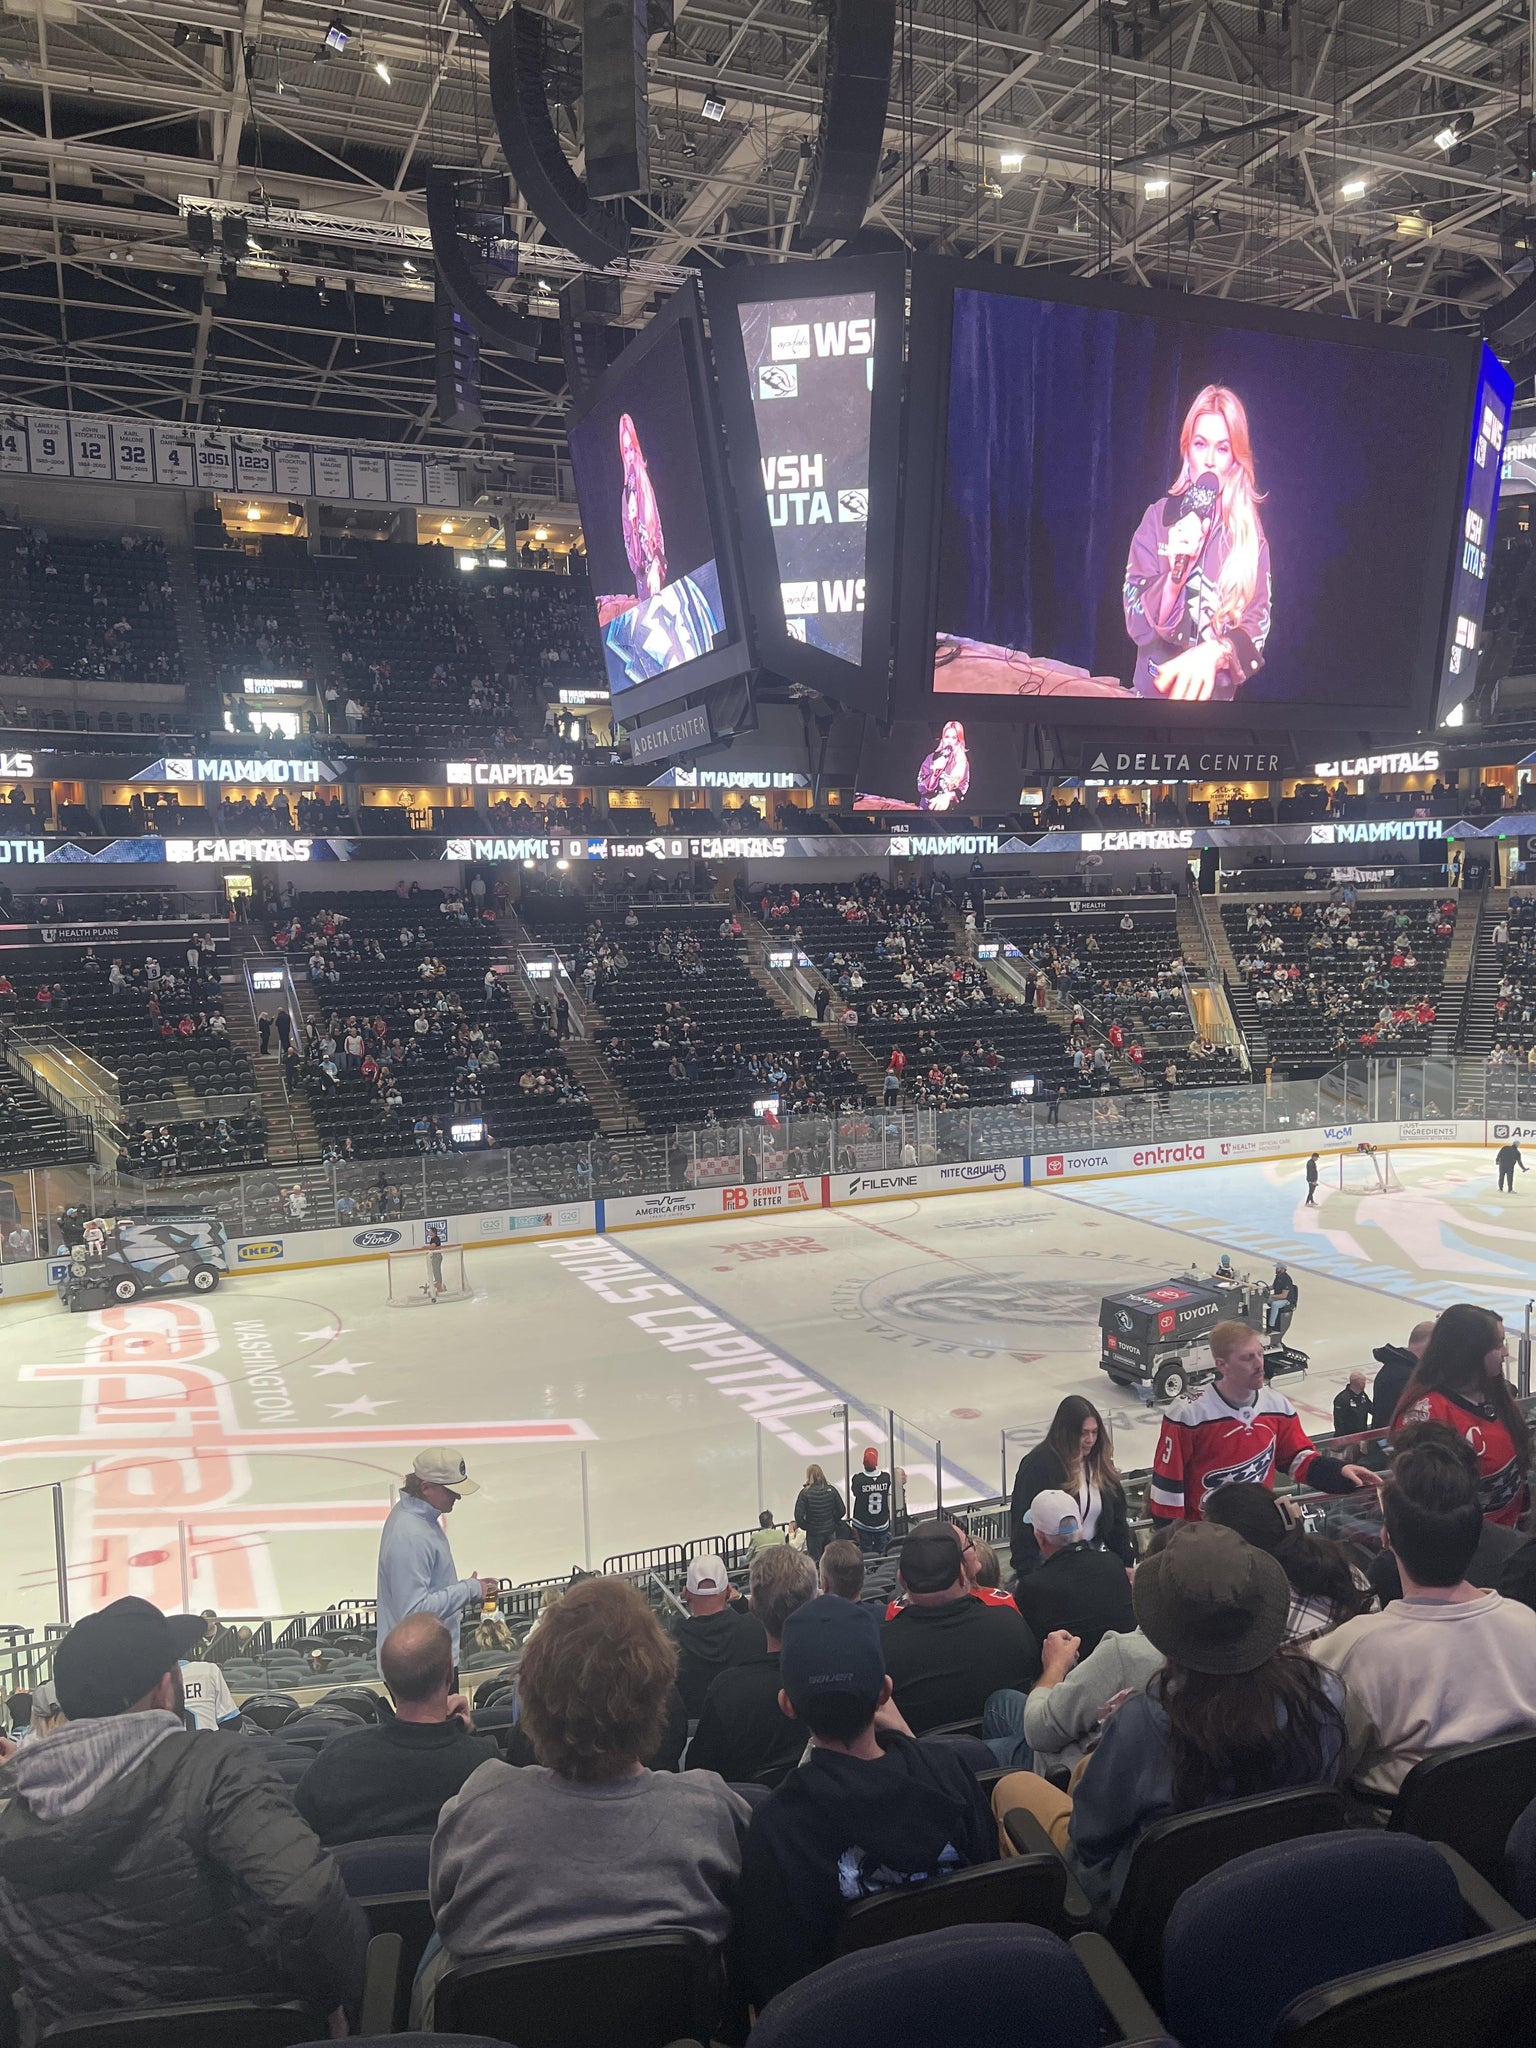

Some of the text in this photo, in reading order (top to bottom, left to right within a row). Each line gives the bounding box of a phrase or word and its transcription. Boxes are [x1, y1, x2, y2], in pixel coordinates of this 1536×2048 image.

[74, 432, 106, 440] STOCKTON
[43, 439, 56, 455] 9
[81, 441, 102, 459] 12
[121, 445, 146, 464] 32
[168, 449, 180, 466] 4
[199, 452, 230, 466] 3051
[238, 456, 269, 469] 1223
[766, 491, 833, 527] UTA
[255, 686, 275, 694] UTAH
[568, 696, 586, 704] UTAH
[640, 716, 706, 752] DELTA CENTER
[198, 760, 319, 782] MAMMOTH
[1116, 754, 1279, 772] DELTA CENTER
[1341, 750, 1439, 776] CAPITALS
[475, 764, 574, 786] CAPITALS
[1337, 820, 1442, 842] MAMMOTH
[570, 841, 581, 856] 0
[671, 840, 682, 856] 0
[701, 838, 785, 858] CAPITALS
[912, 835, 999, 855] MAMMOTH
[1104, 831, 1193, 850] CAPITALS
[198, 839, 311, 862] CAPITALS
[610, 844, 644, 857] 15:00
[1082, 902, 1106, 910] HEALTH
[59, 928, 119, 938] HEALTH PLANS
[1323, 1127, 1353, 1140] VLCM
[1403, 1128, 1454, 1136] INGREDIENTS
[1133, 1143, 1205, 1166] entrata
[1232, 1143, 1256, 1151] HEALTH
[1067, 1157, 1109, 1169] TOYOTA
[862, 1176, 918, 1190] FILEVINE
[722, 1187, 749, 1211] PB
[752, 1186, 782, 1197] PEANUT
[635, 1203, 696, 1216] AMERICA FIRST
[727, 1201, 735, 1210] fit
[753, 1196, 782, 1207] BETTER
[518, 1216, 535, 1224] G2G
[561, 1211, 577, 1220] G2G
[482, 1220, 500, 1229] G2G
[362, 1230, 396, 1246] Ford
[707, 1236, 815, 1254] GEEK
[244, 1245, 281, 1257] IKEA
[737, 1244, 830, 1262] SEAT
[832, 1277, 871, 1321] CENTER
[1126, 1293, 1164, 1309] TOYOTA
[1178, 1302, 1219, 1323] TOYOTA
[863, 1323, 997, 1360] DELTA
[1118, 1341, 1141, 1356] TOYOTA
[232, 1319, 299, 1424] WASHINGTON
[628, 1305, 891, 1457] CAPITALS
[1162, 1436, 1173, 1464] 3
[868, 1492, 882, 1514] 8
[185, 1683, 202, 1699] ER
